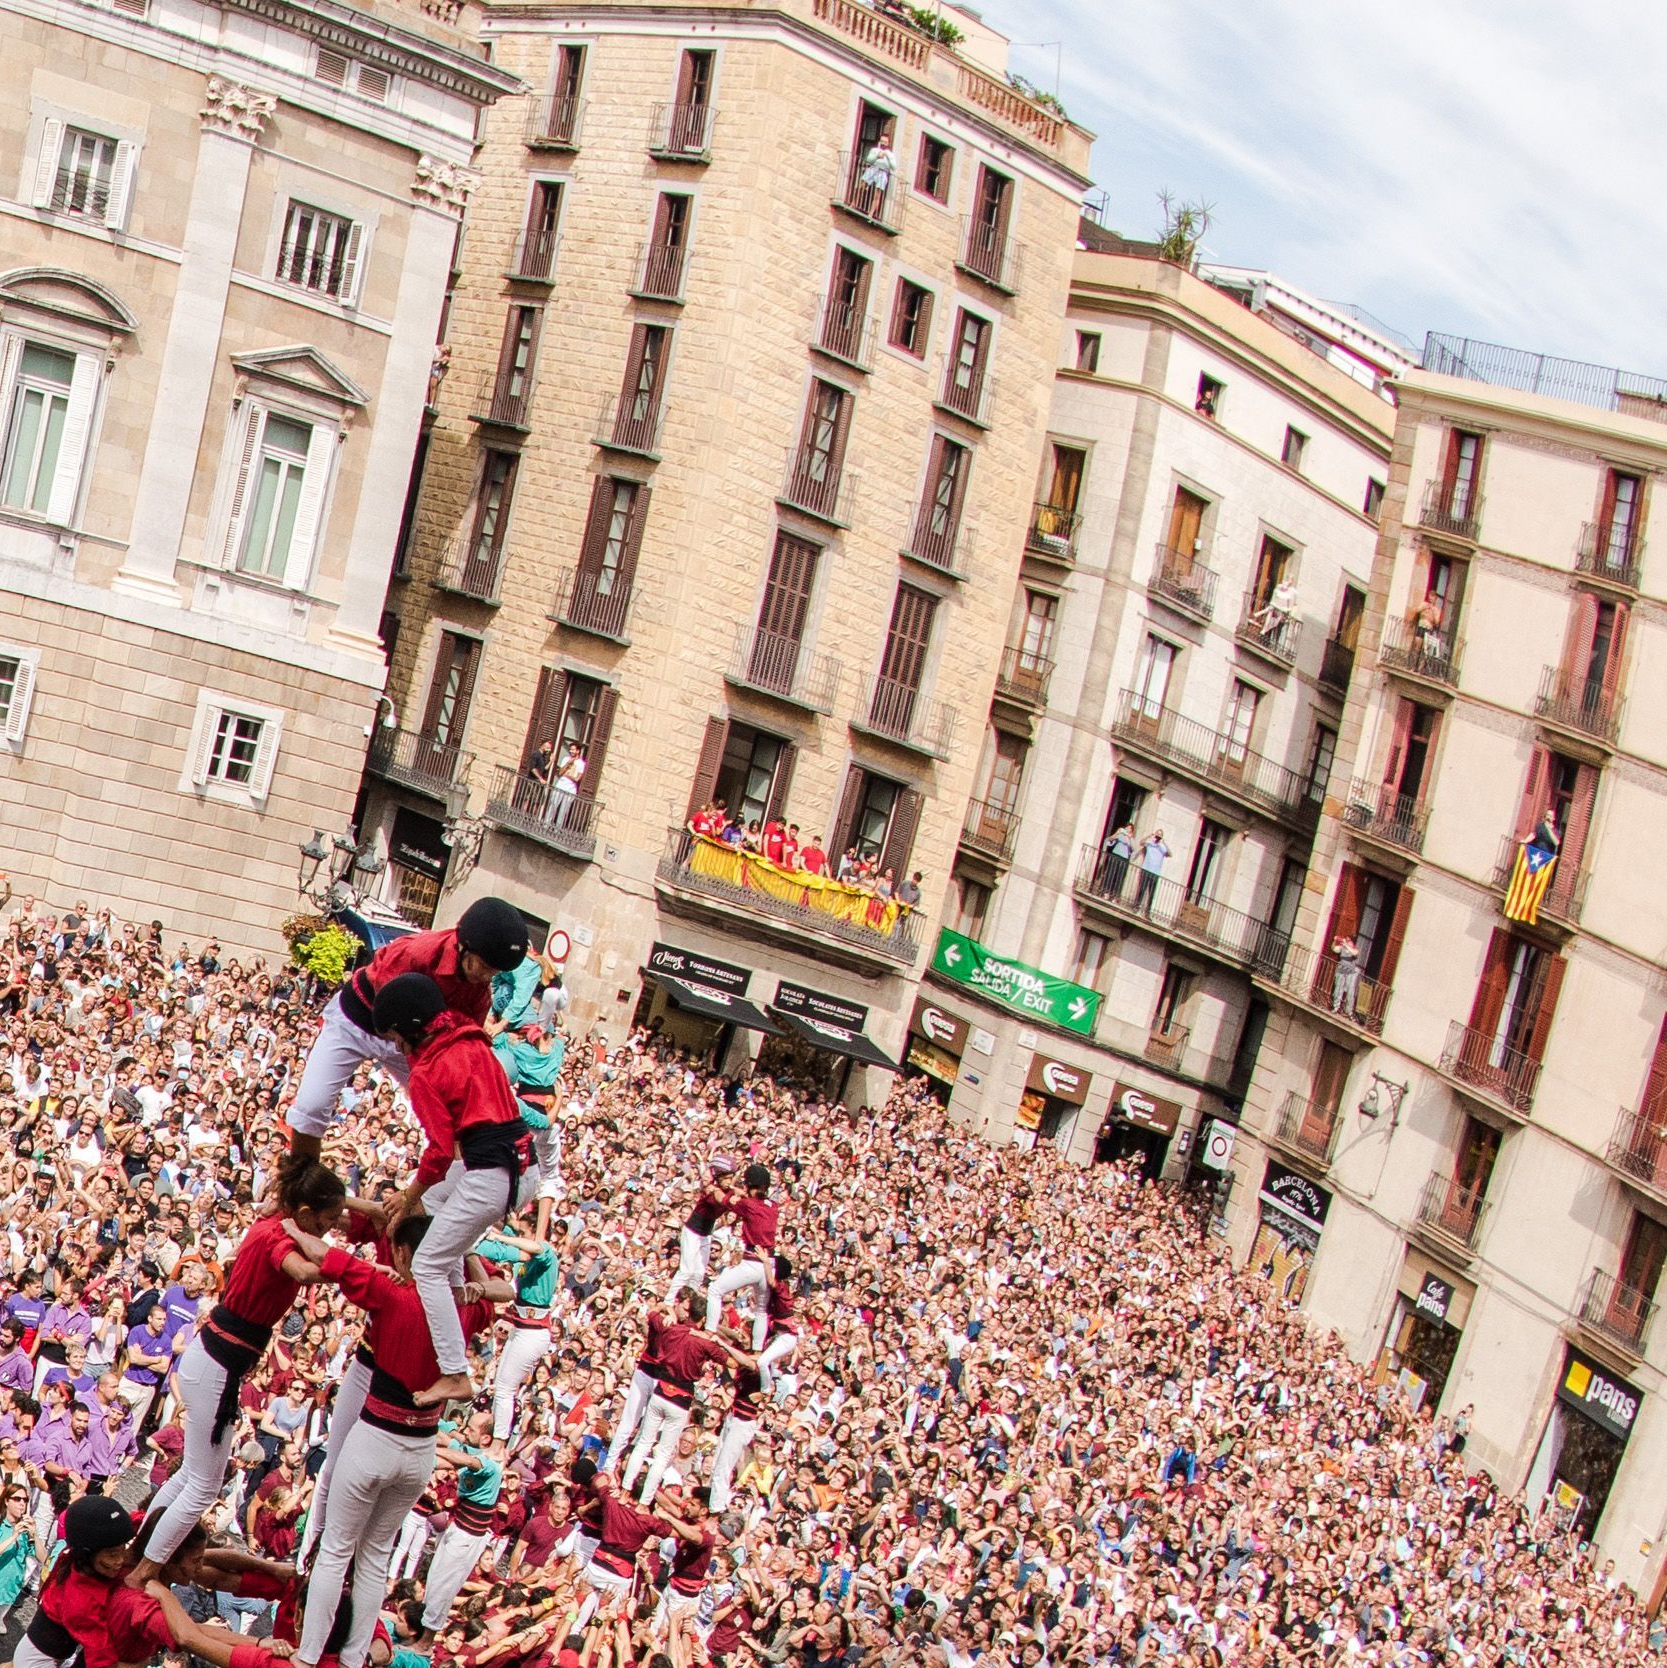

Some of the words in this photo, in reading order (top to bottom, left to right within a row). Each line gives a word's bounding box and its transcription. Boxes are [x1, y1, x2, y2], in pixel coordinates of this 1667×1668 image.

[970, 968, 1011, 1001] SALIDA
[1023, 992, 1053, 1014] EXIT
[983, 957, 1044, 995] SORTIDA
[1272, 1175, 1321, 1216] BARCELONA
[1416, 1292, 1445, 1317] pans
[1585, 1374, 1636, 1420] pans
